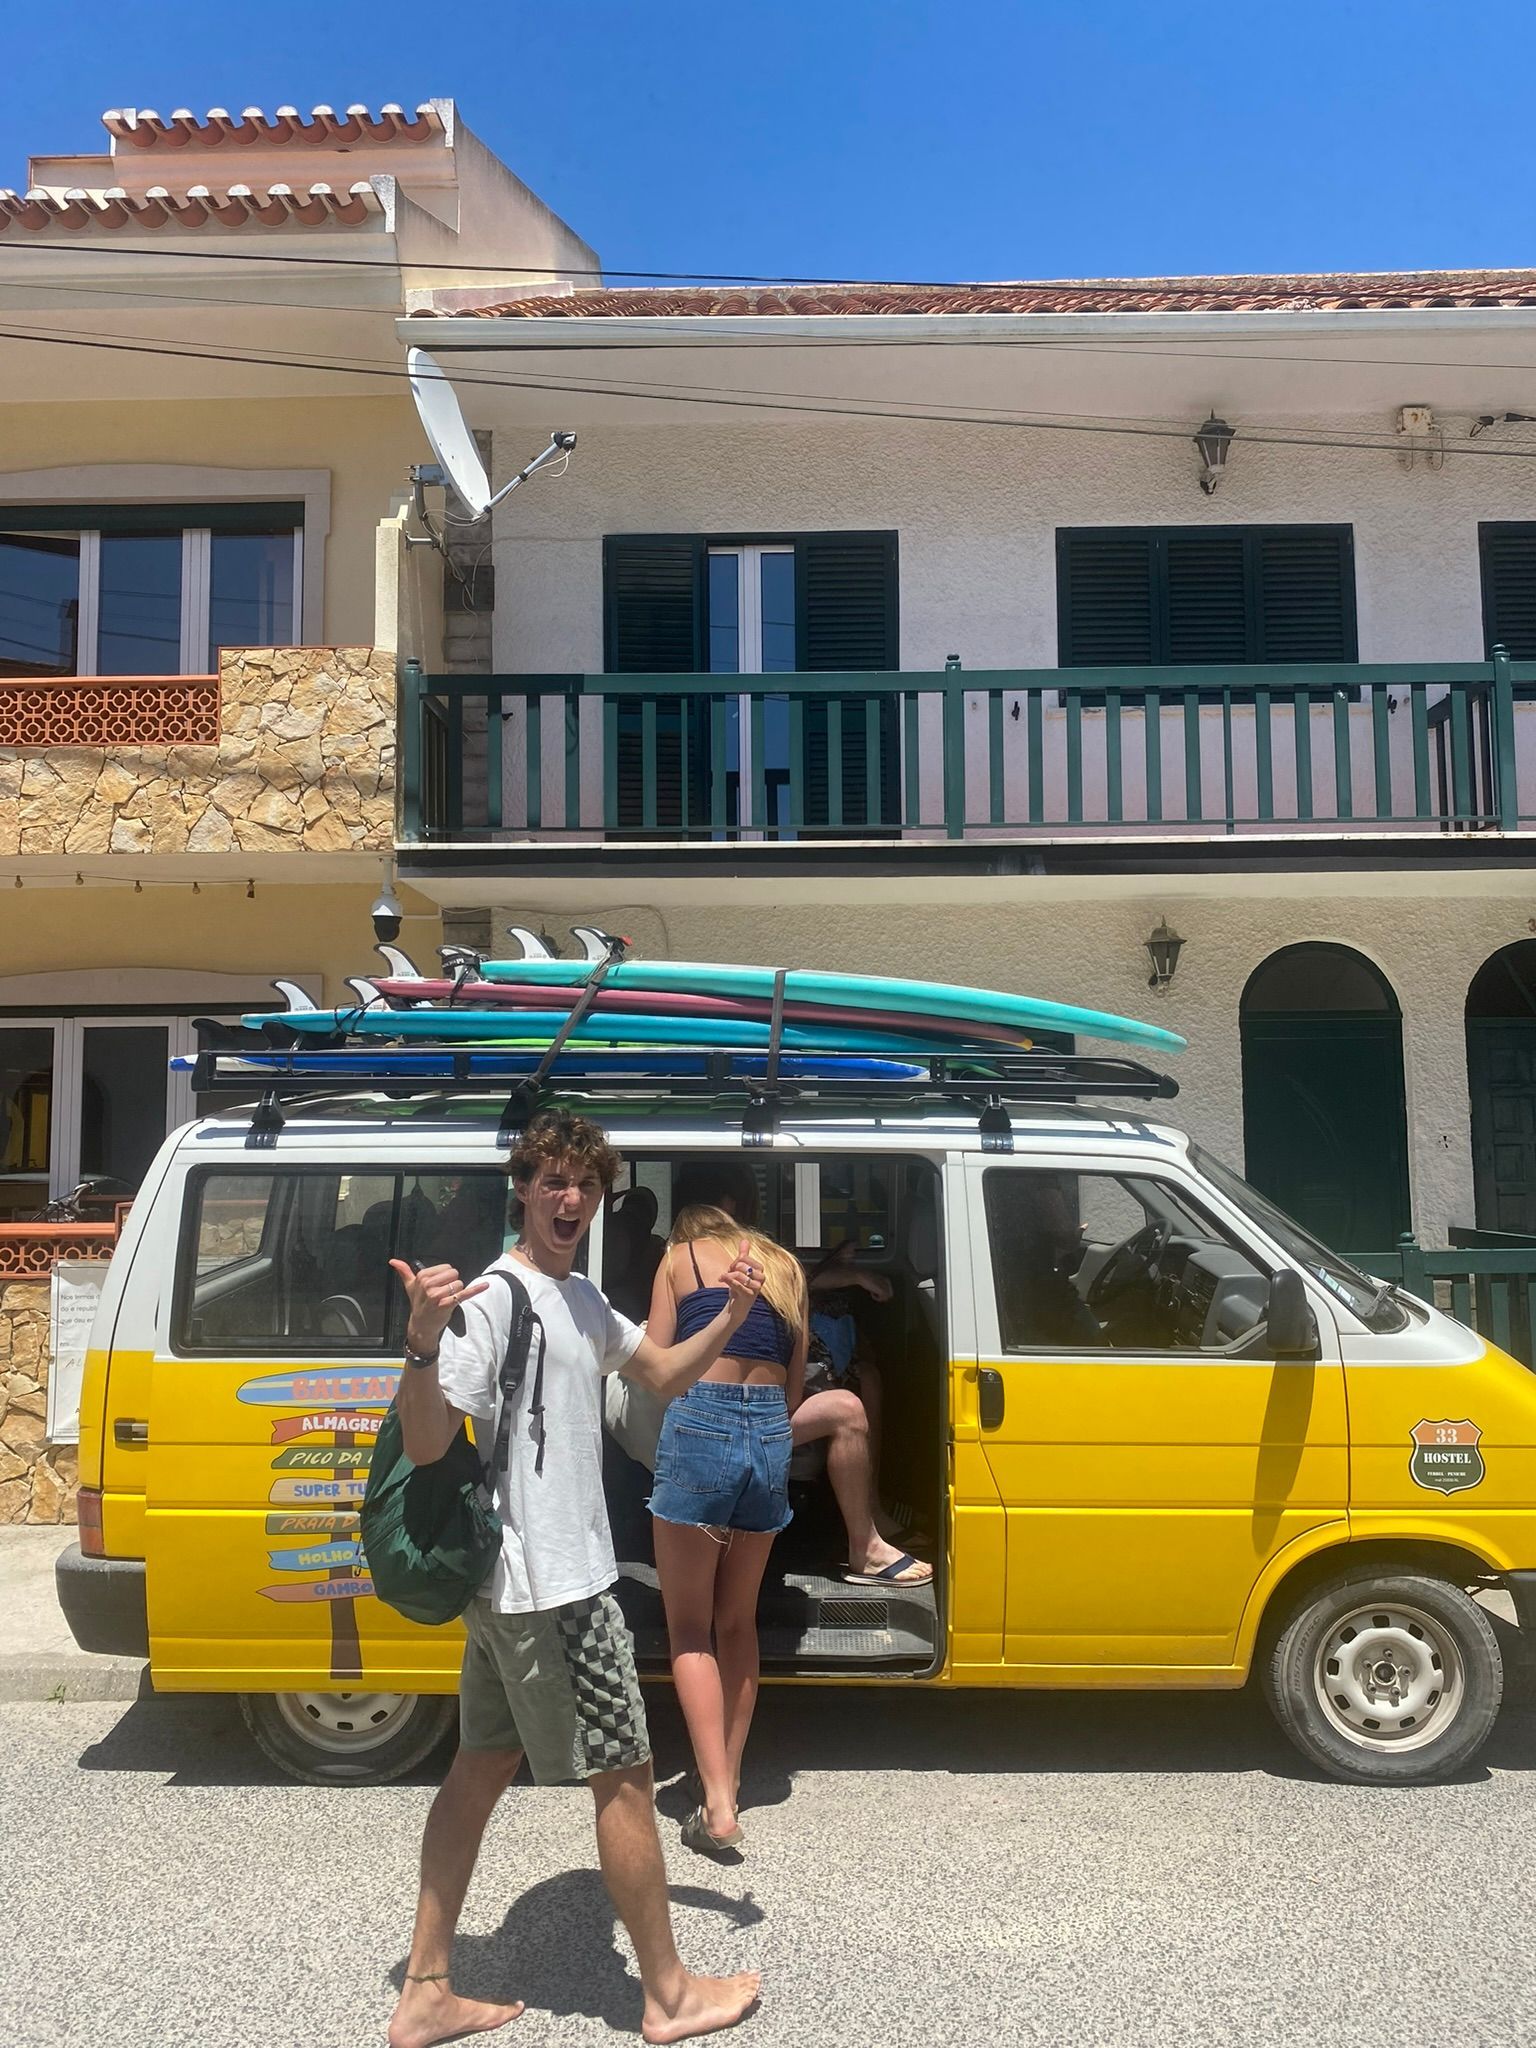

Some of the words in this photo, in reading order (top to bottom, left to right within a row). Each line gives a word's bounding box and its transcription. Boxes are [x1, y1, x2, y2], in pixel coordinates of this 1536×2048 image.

[1436, 1428, 1457, 1443] 33
[288, 1452, 334, 1466] PICO
[338, 1452, 362, 1466] DA
[1423, 1452, 1471, 1464] HOSTEL
[294, 1483, 341, 1497] SUPER
[280, 1516, 336, 1531] PRAIA
[298, 1550, 354, 1566] MOLHO
[314, 1583, 373, 1595] GAMBO
